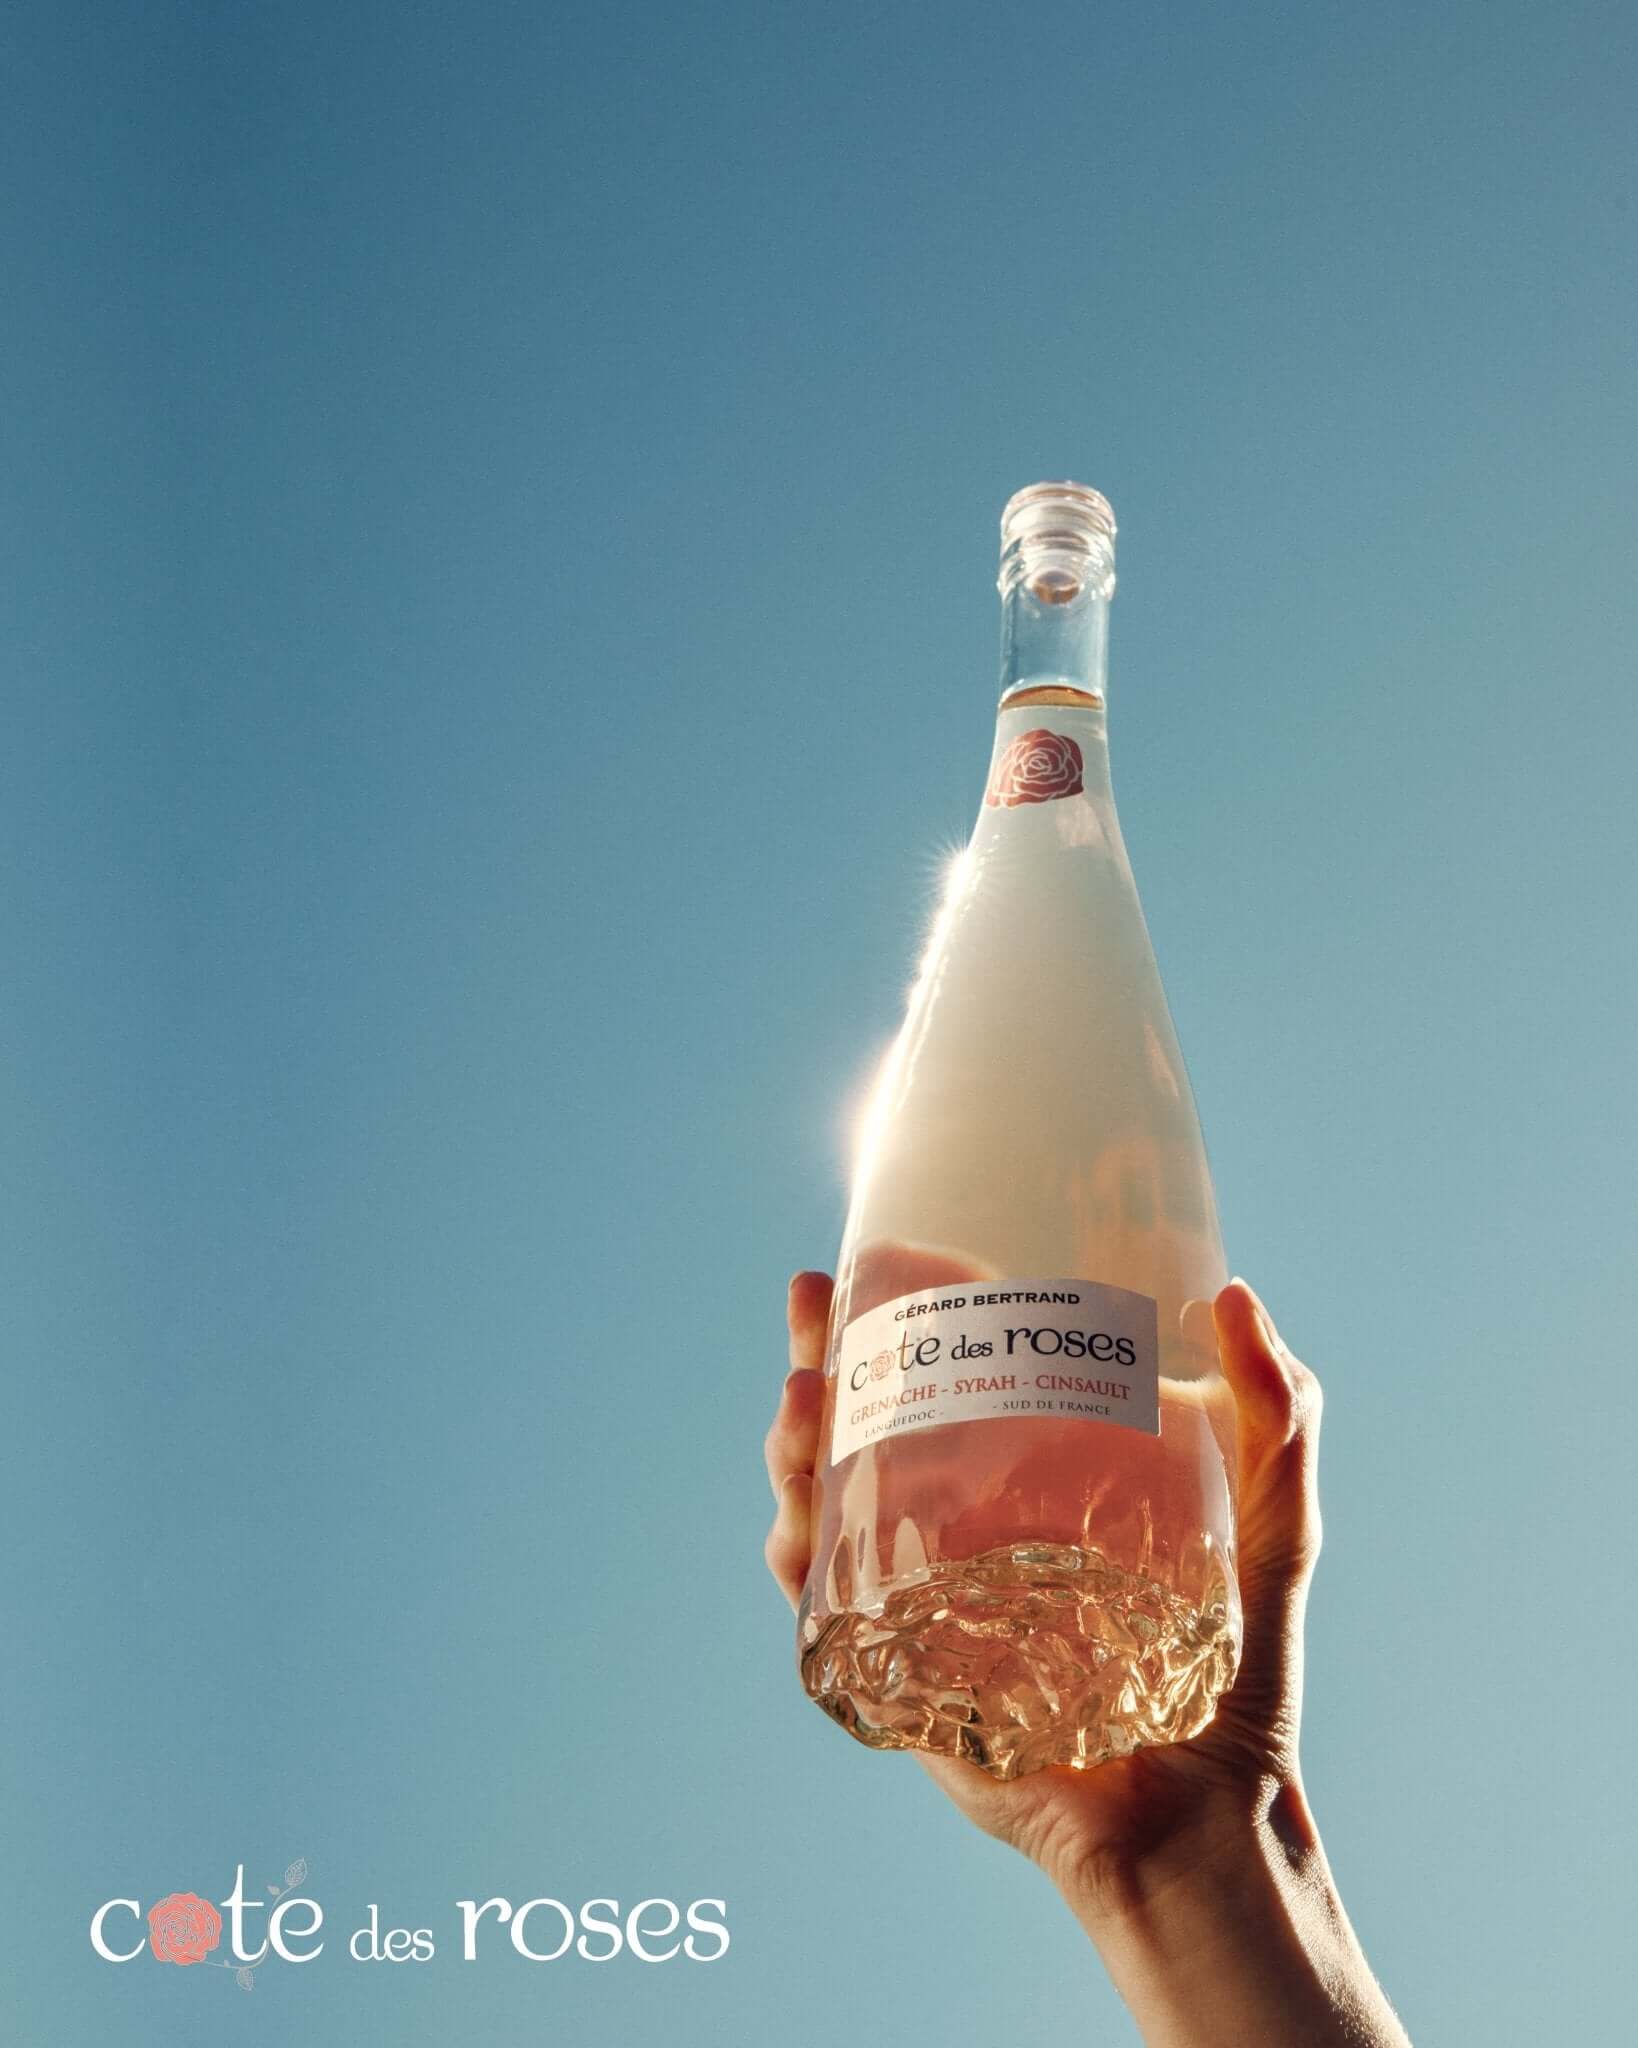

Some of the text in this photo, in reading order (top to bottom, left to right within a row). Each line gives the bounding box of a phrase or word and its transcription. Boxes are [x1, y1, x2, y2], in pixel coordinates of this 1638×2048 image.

[894, 1291, 1081, 1322] GÉRARD BERTRAND
[950, 1334, 994, 1361] des
[1003, 1326, 1137, 1367] roses
[850, 1383, 937, 1426] GRENACHE
[953, 1375, 1017, 1395] SYRAH
[1035, 1374, 1131, 1401] CINSAULT
[864, 1408, 937, 1439] LANGUEDOC
[1001, 1400, 1031, 1410] SUD
[1036, 1400, 1054, 1411] DE
[1058, 1400, 1112, 1416] FRANCE
